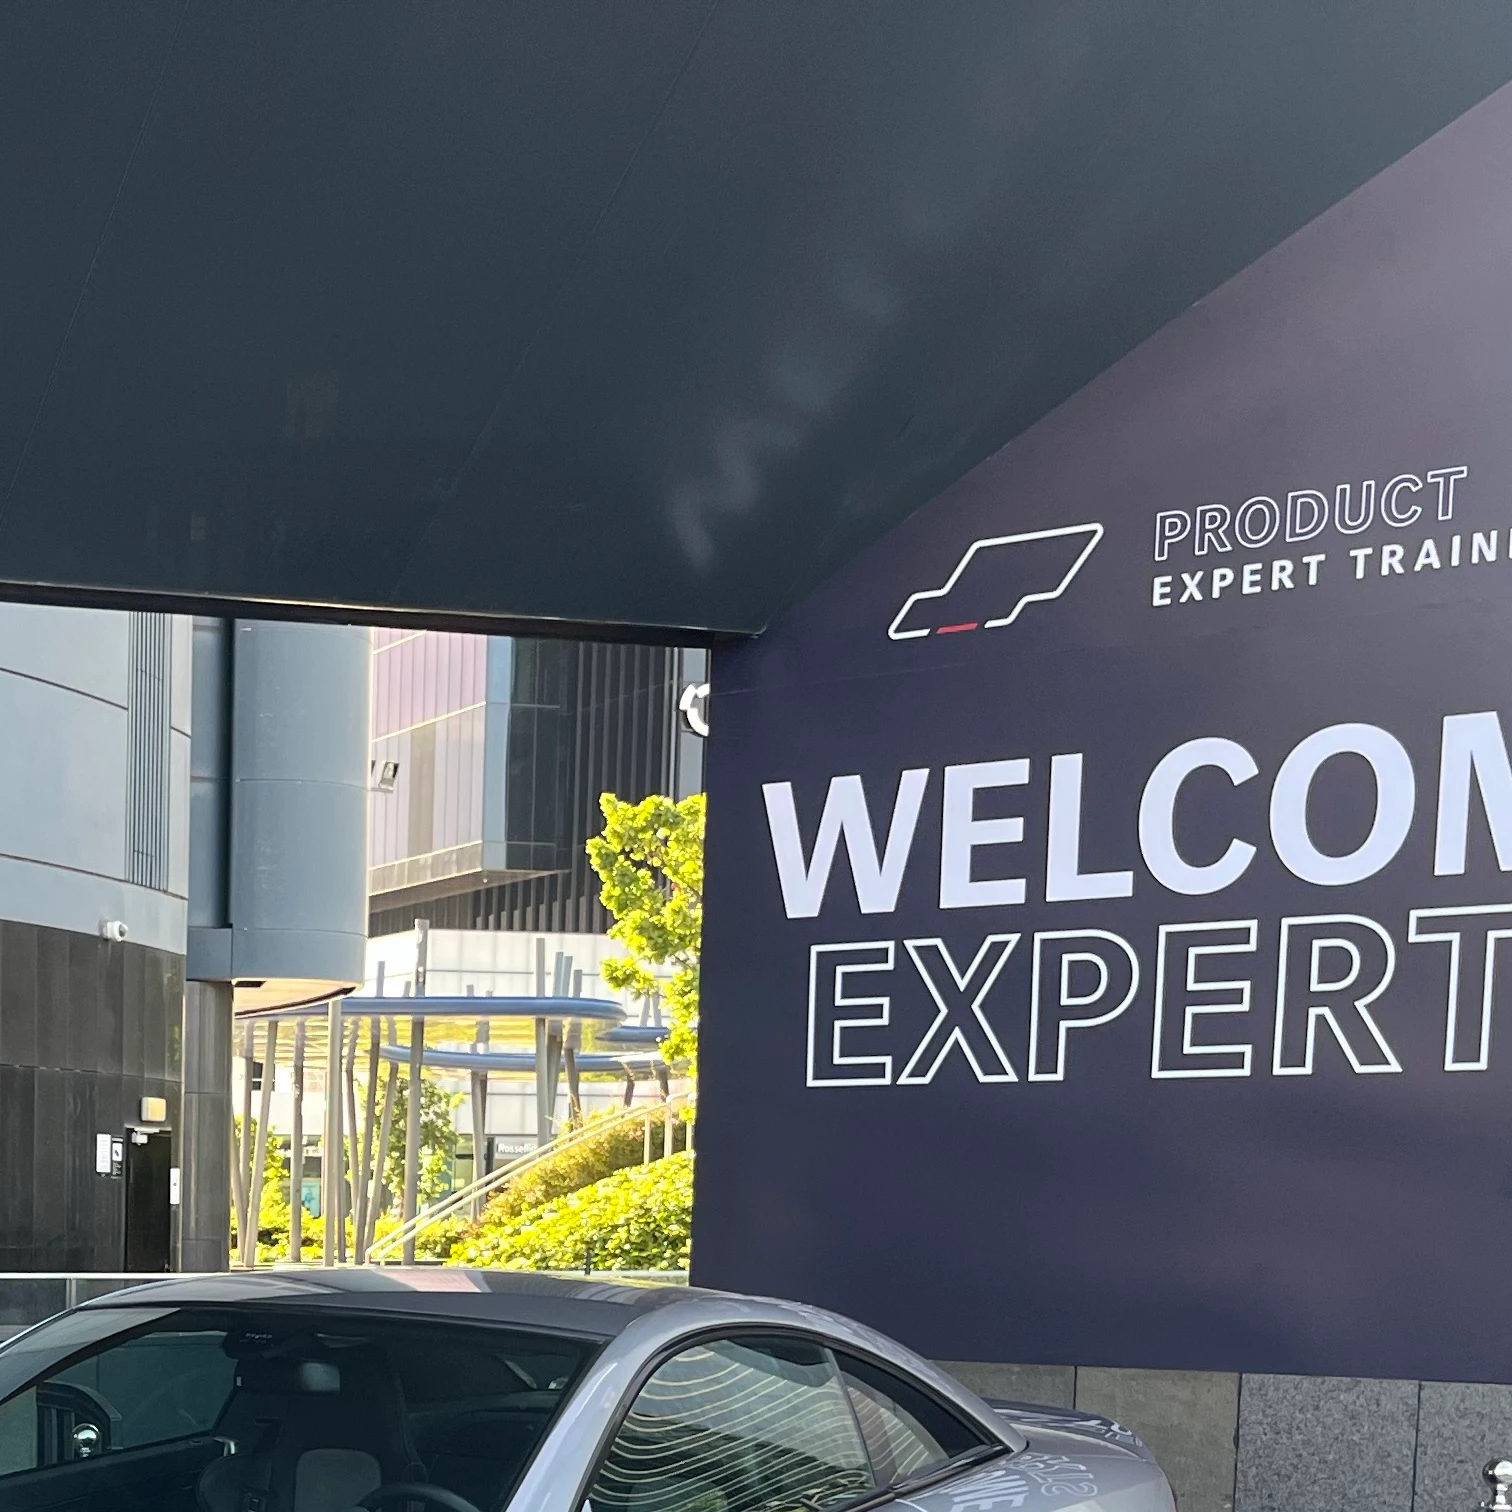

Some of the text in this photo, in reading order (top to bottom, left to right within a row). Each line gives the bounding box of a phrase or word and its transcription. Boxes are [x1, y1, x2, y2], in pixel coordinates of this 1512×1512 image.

[1154, 465, 1468, 562] PRODUCT
[1151, 554, 1327, 607] EXPERT
[806, 904, 1512, 1088] EXPERT
